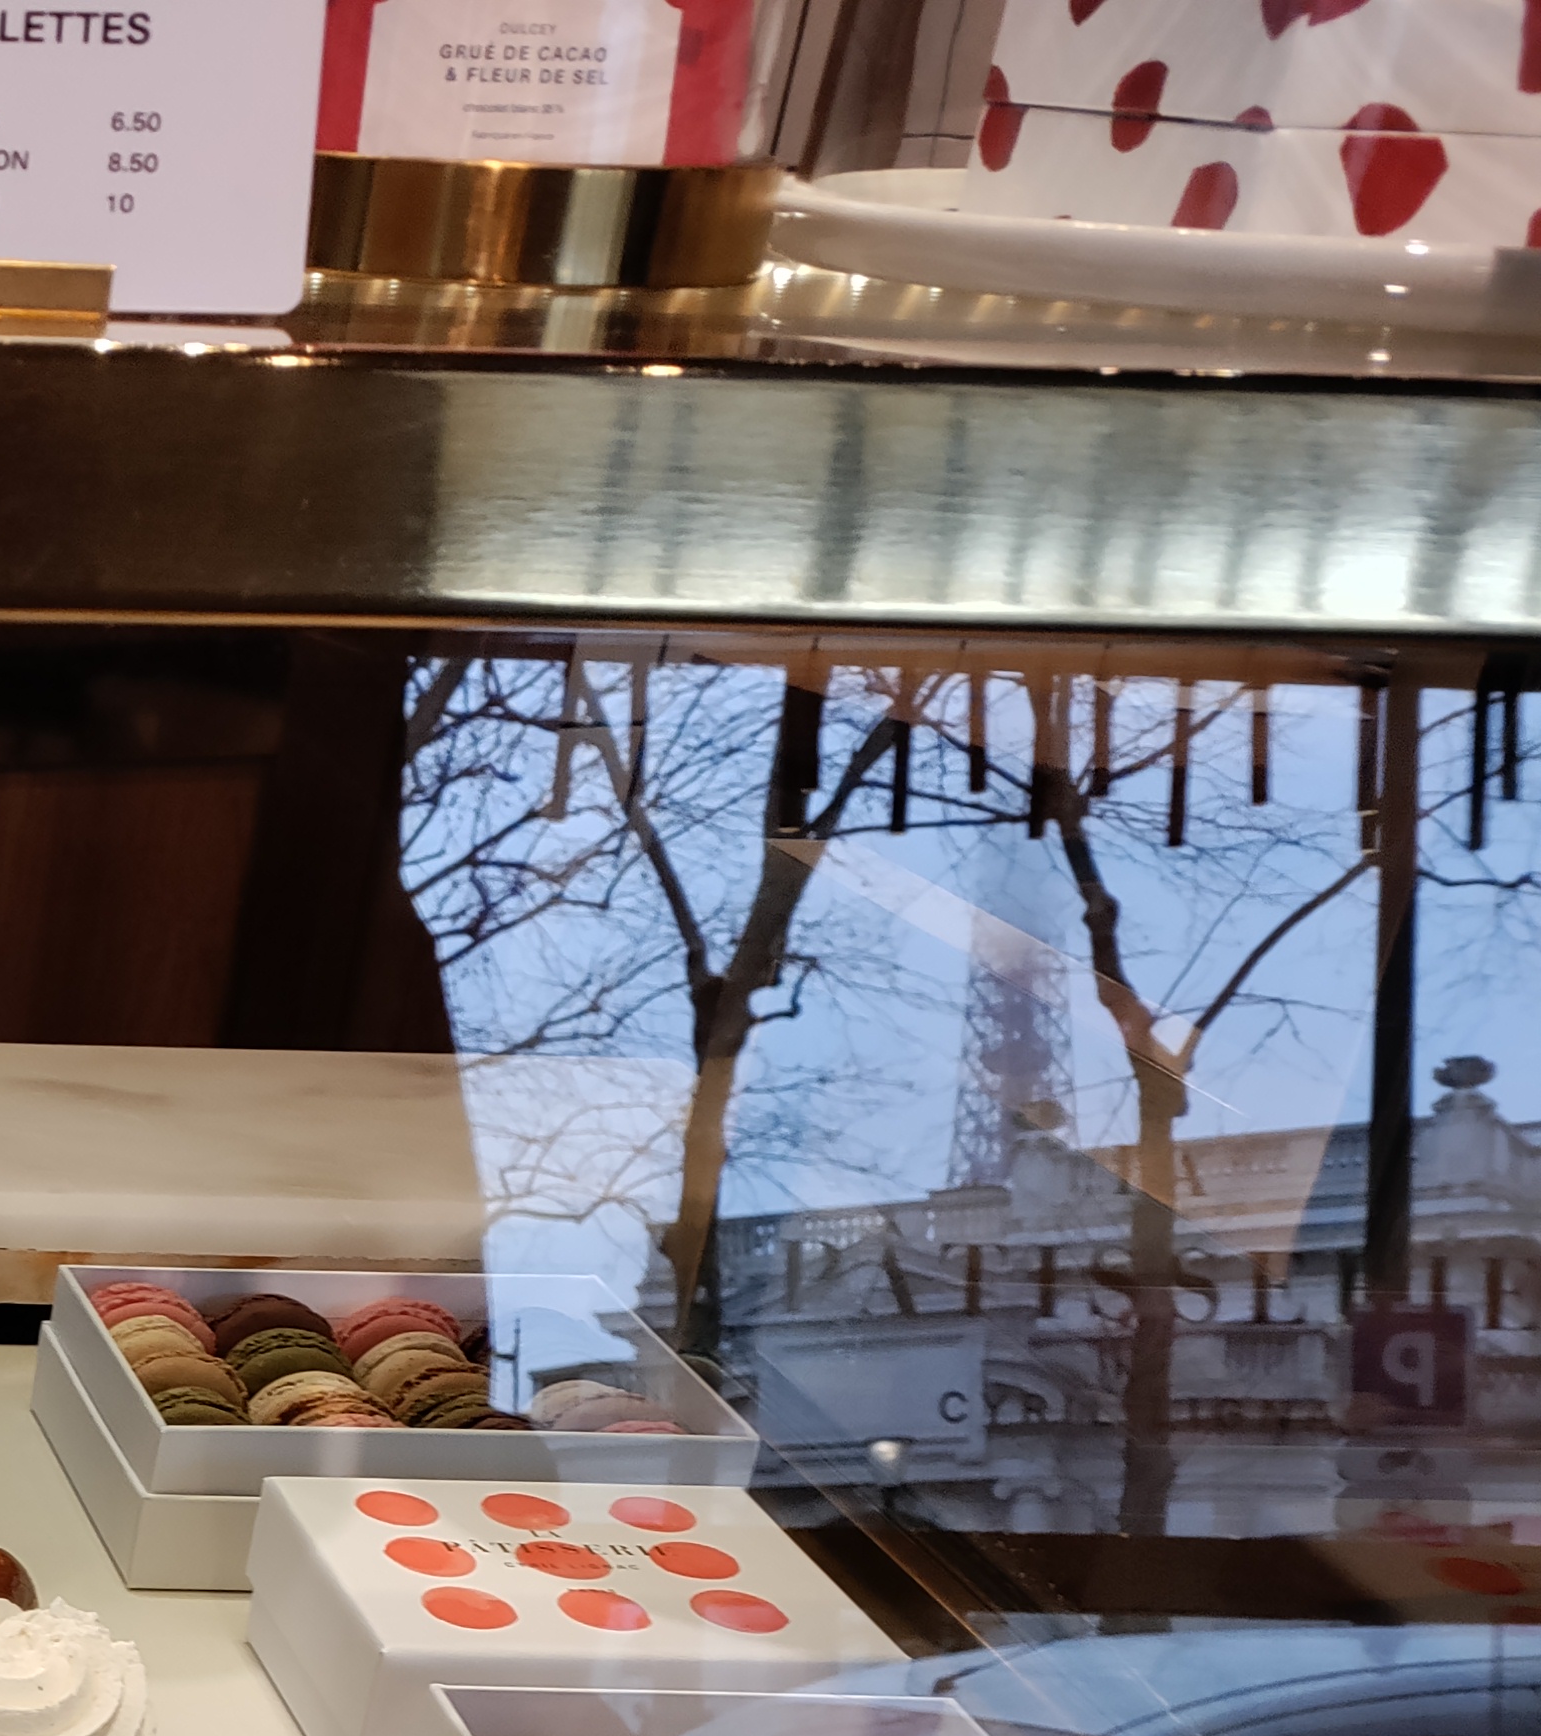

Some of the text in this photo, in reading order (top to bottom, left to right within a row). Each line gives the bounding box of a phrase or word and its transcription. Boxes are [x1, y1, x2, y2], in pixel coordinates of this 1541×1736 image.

[439, 41, 608, 63] GRUÉ DE CACAO
[445, 66, 609, 85] & FLEUR DE SEL
[111, 112, 161, 132] 6.50
[108, 153, 158, 173] 8.50
[108, 193, 134, 213] 10
